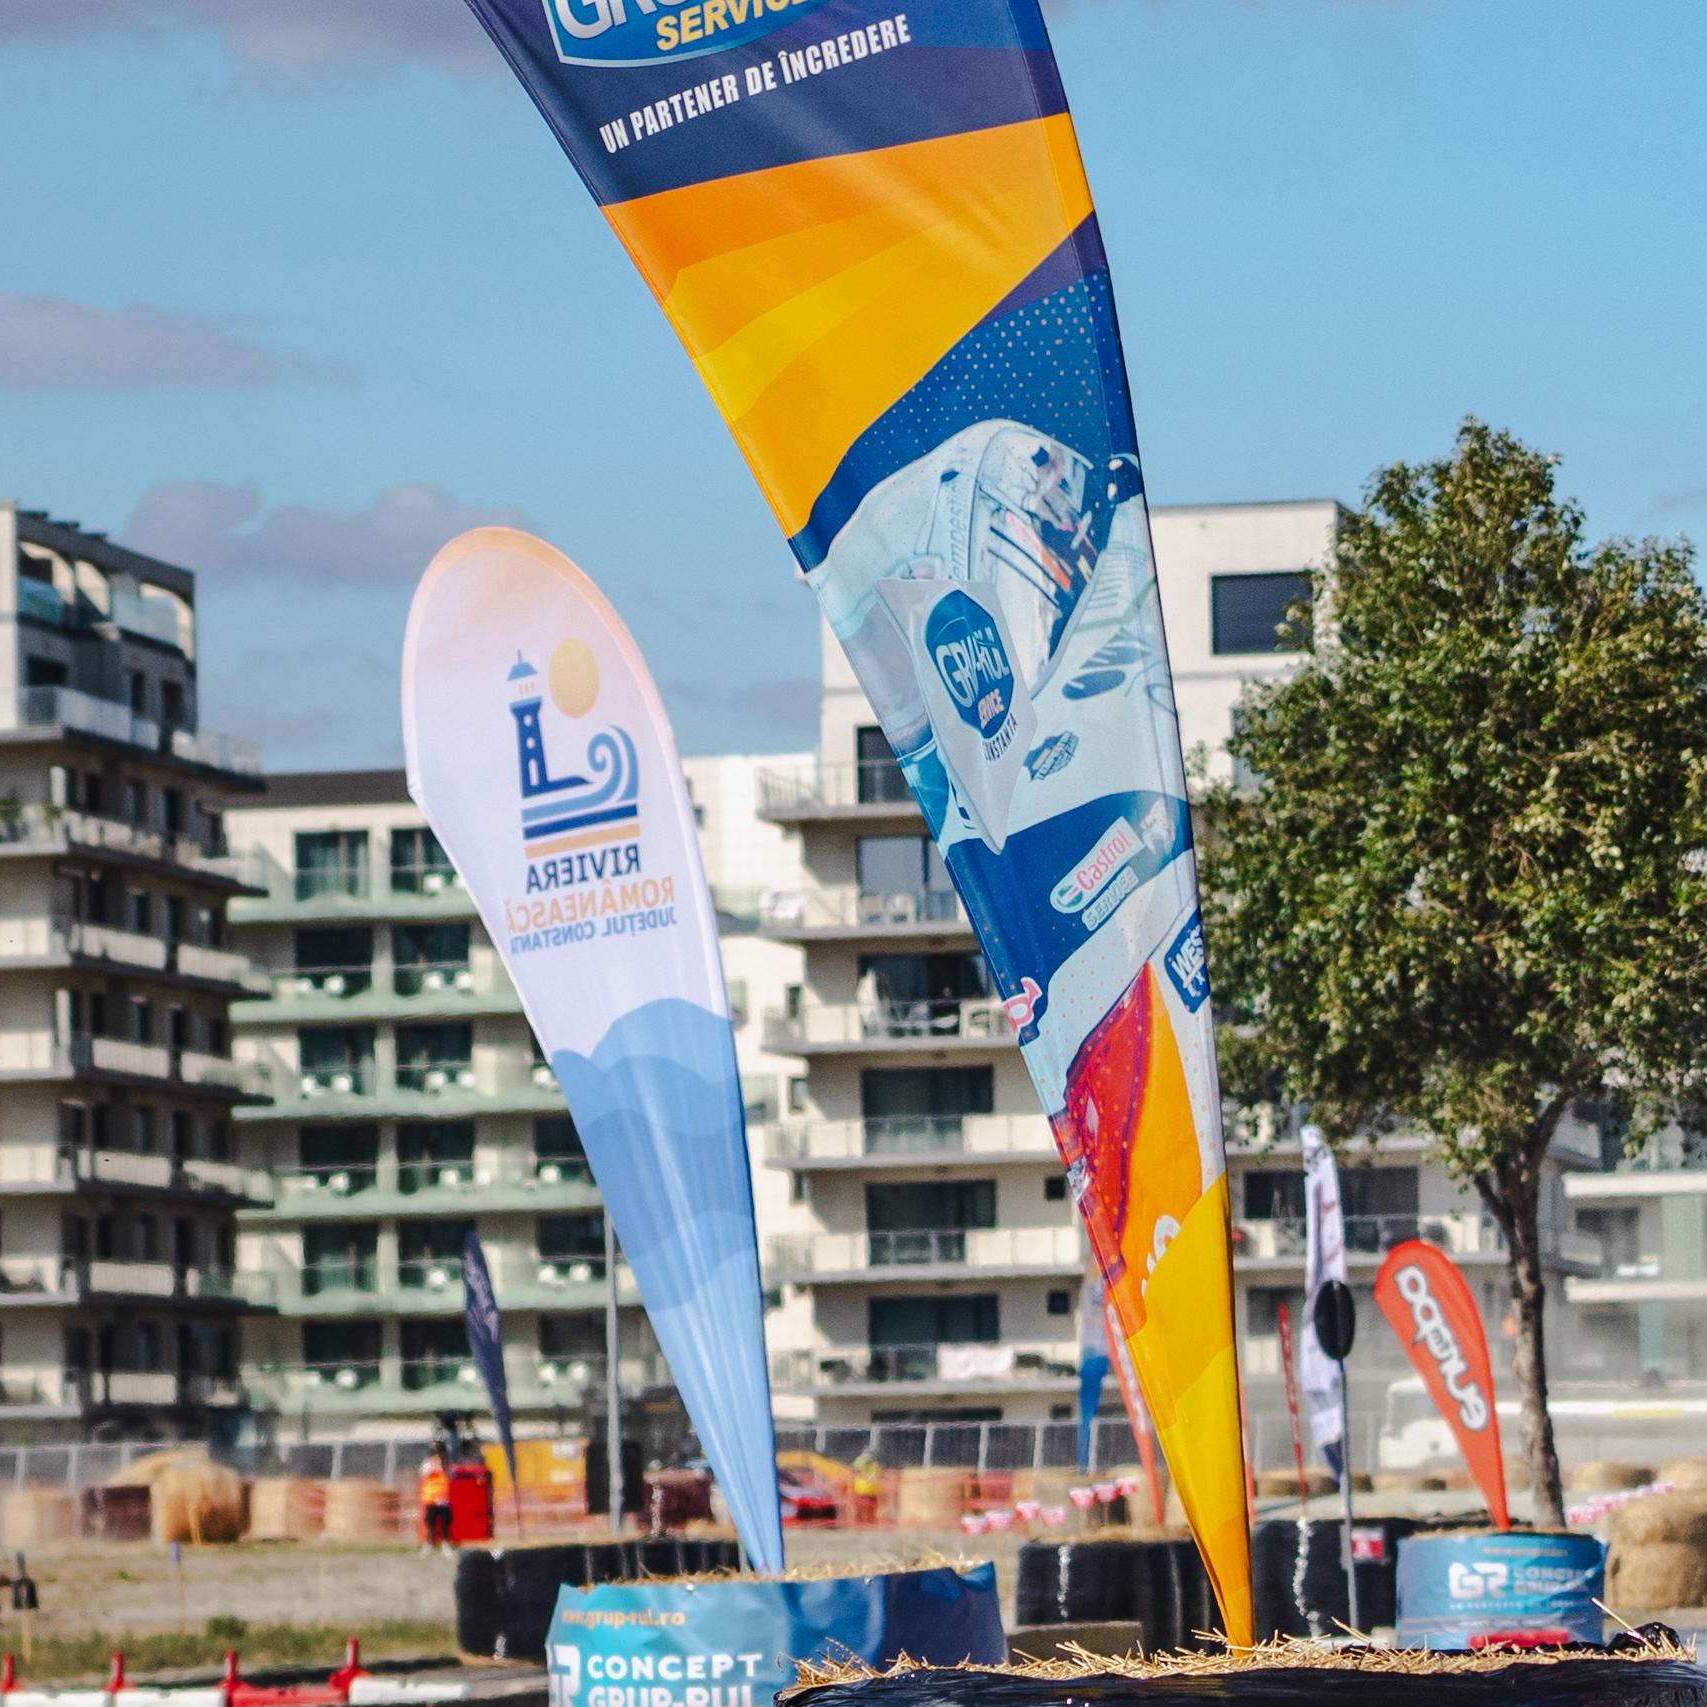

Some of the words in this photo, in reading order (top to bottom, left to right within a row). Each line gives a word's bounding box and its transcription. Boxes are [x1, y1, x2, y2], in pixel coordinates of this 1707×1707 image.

[599, 118, 630, 154] UN
[629, 74, 740, 141] PARTENER
[744, 60, 777, 96] DE
[777, 14, 912, 85] ÎNCREDERE
[1075, 829, 1133, 892] Castrol
[587, 1653, 763, 1681] CONCEPT
